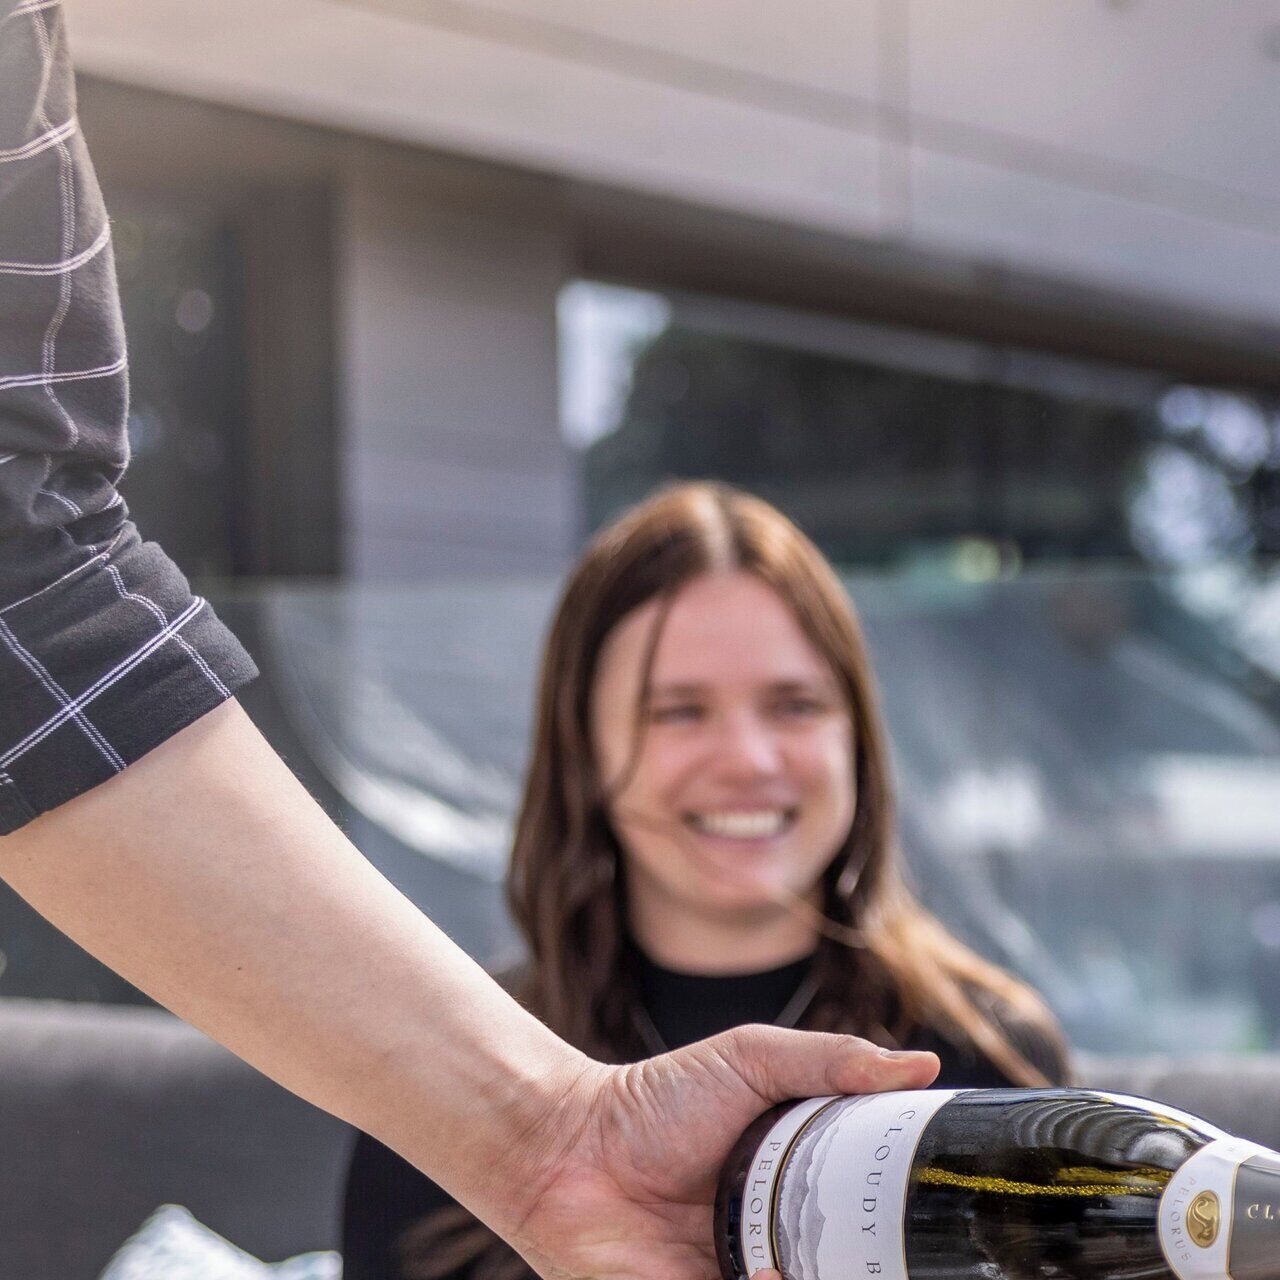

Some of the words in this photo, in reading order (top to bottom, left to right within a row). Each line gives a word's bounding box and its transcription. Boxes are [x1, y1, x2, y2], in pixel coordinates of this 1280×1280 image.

[749, 1141, 783, 1271] PELORU
[861, 1109, 916, 1237] CLOUDY
[1170, 1175, 1197, 1262] PELORUS
